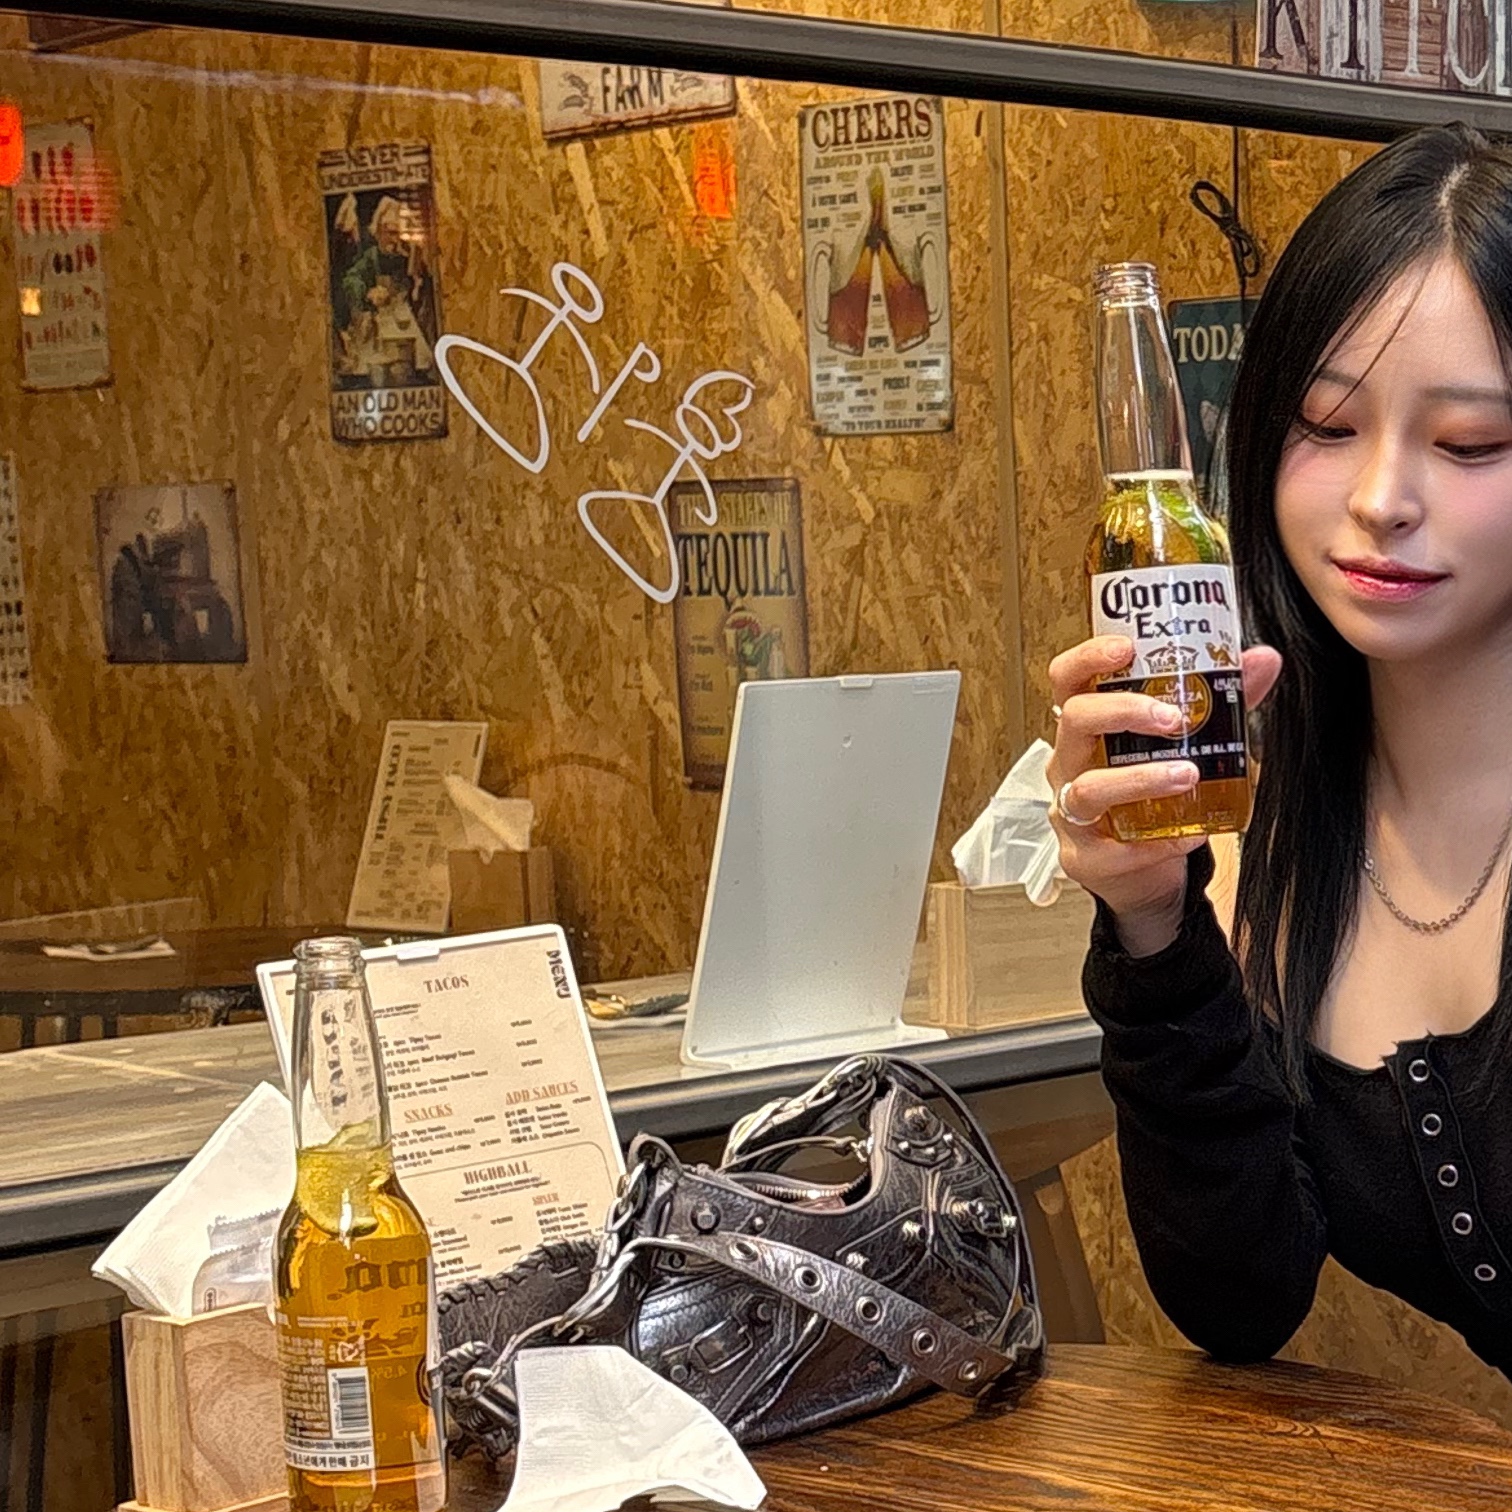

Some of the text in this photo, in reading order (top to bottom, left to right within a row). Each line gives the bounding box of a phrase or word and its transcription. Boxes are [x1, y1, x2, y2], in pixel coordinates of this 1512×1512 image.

[602, 65, 665, 114] FARM
[811, 97, 934, 149] CHEERS
[349, 144, 400, 168] NEVER
[865, 150, 890, 164] THE
[1173, 323, 1246, 364] TODA
[335, 388, 440, 414] AN OLD MAN
[334, 411, 441, 436] WHO COOKS
[677, 530, 796, 609] TEQUILA
[1101, 575, 1230, 623] Corona
[1135, 611, 1212, 640] Extra
[423, 974, 469, 994] TACOS
[547, 949, 572, 999] MENU
[504, 1080, 579, 1105] ADD SAUCES
[403, 1102, 453, 1123] SNACKS
[463, 1160, 533, 1185] HIGHBALL
[349, 1454, 370, 1468] 금지
